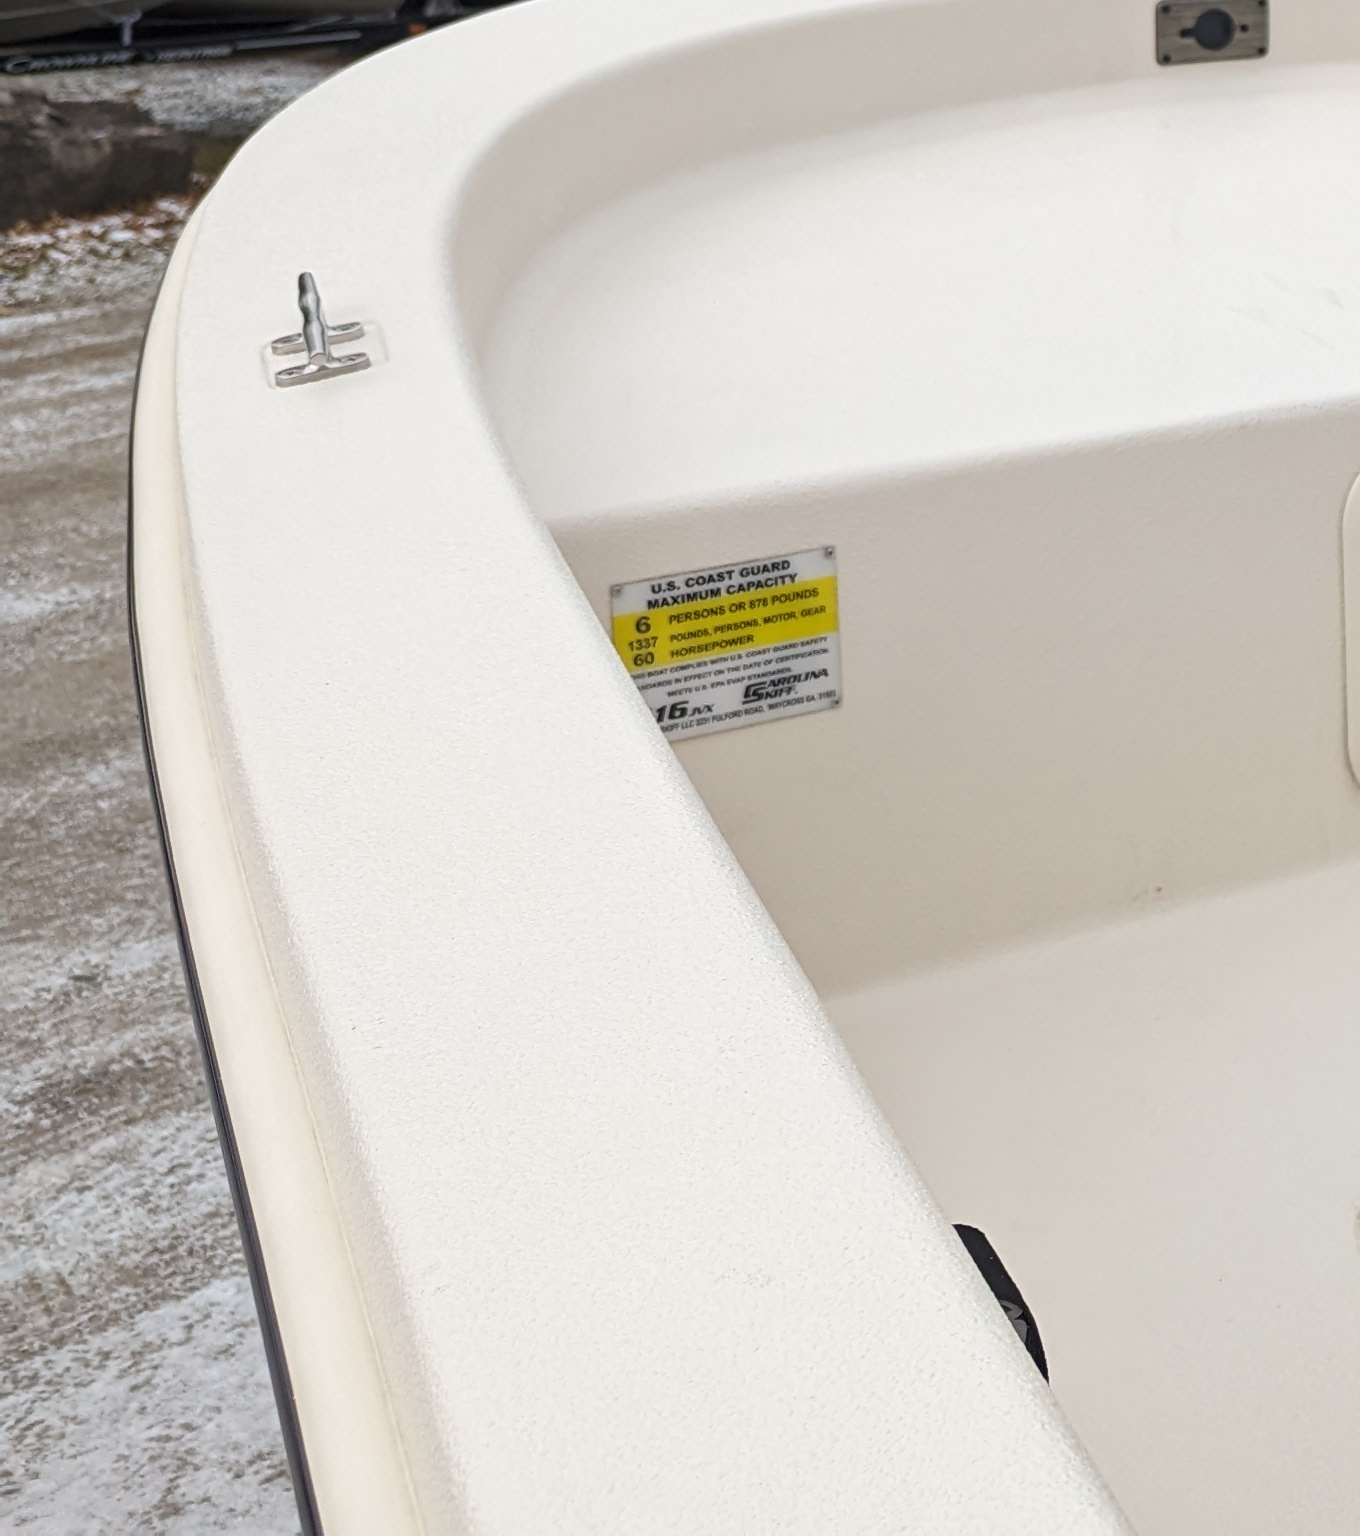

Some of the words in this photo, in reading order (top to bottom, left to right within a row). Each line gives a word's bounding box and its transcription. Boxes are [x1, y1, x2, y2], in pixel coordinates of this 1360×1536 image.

[647, 587, 721, 610] MAXIMUM
[726, 573, 798, 595] CAPACITY
[651, 580, 681, 594] U.S.
[685, 570, 735, 588] COAST
[740, 560, 791, 578] GUARD
[635, 616, 651, 634] 6
[669, 605, 726, 625] PERSONS
[729, 601, 747, 614] OR
[750, 597, 769, 610] 878
[771, 587, 819, 607] POUNDS
[628, 636, 659, 652] 1337
[670, 628, 712, 643] POUNDS,
[714, 618, 762, 634] PERSONS,
[801, 605, 826, 618] GEAR
[633, 651, 655, 667] 60
[671, 634, 754, 658] HORSEPOWER
[742, 685, 796, 704] SKIFF
[743, 668, 829, 699] CAROLINA
[656, 700, 689, 724] 16
